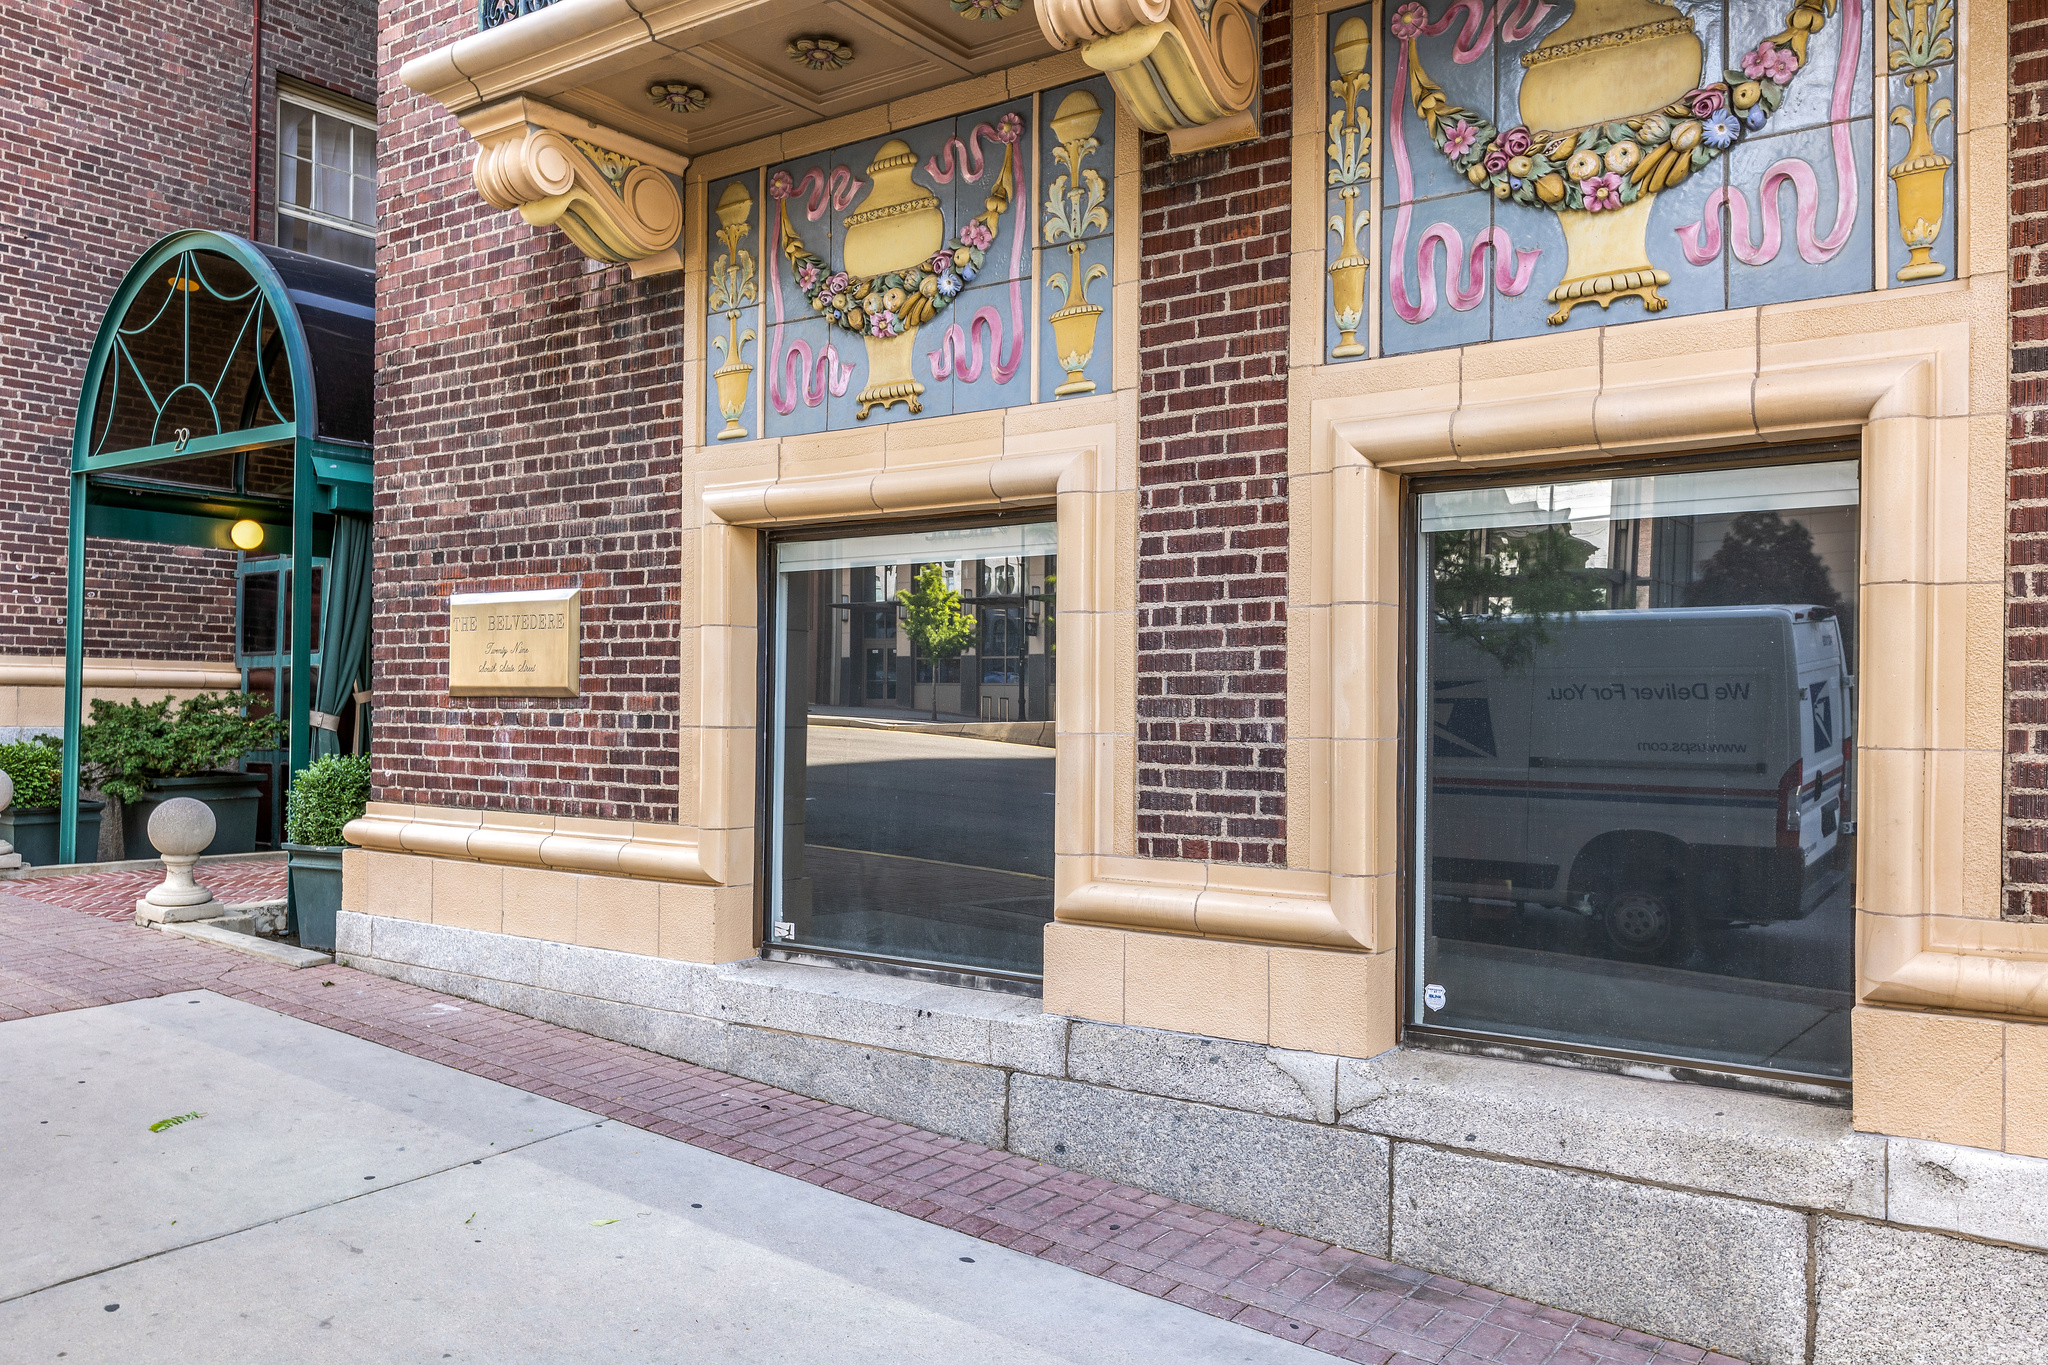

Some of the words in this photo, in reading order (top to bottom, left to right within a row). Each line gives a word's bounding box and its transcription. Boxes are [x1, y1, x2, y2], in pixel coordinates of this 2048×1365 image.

[174, 427, 190, 451] 29
[453, 616, 478, 632] THE
[487, 613, 565, 631] BELVEDERE
[484, 642, 508, 658] Twenty
[510, 641, 529, 655] Nine
[478, 660, 497, 673] South
[499, 660, 515, 673] State
[517, 659, 537, 673] Street
